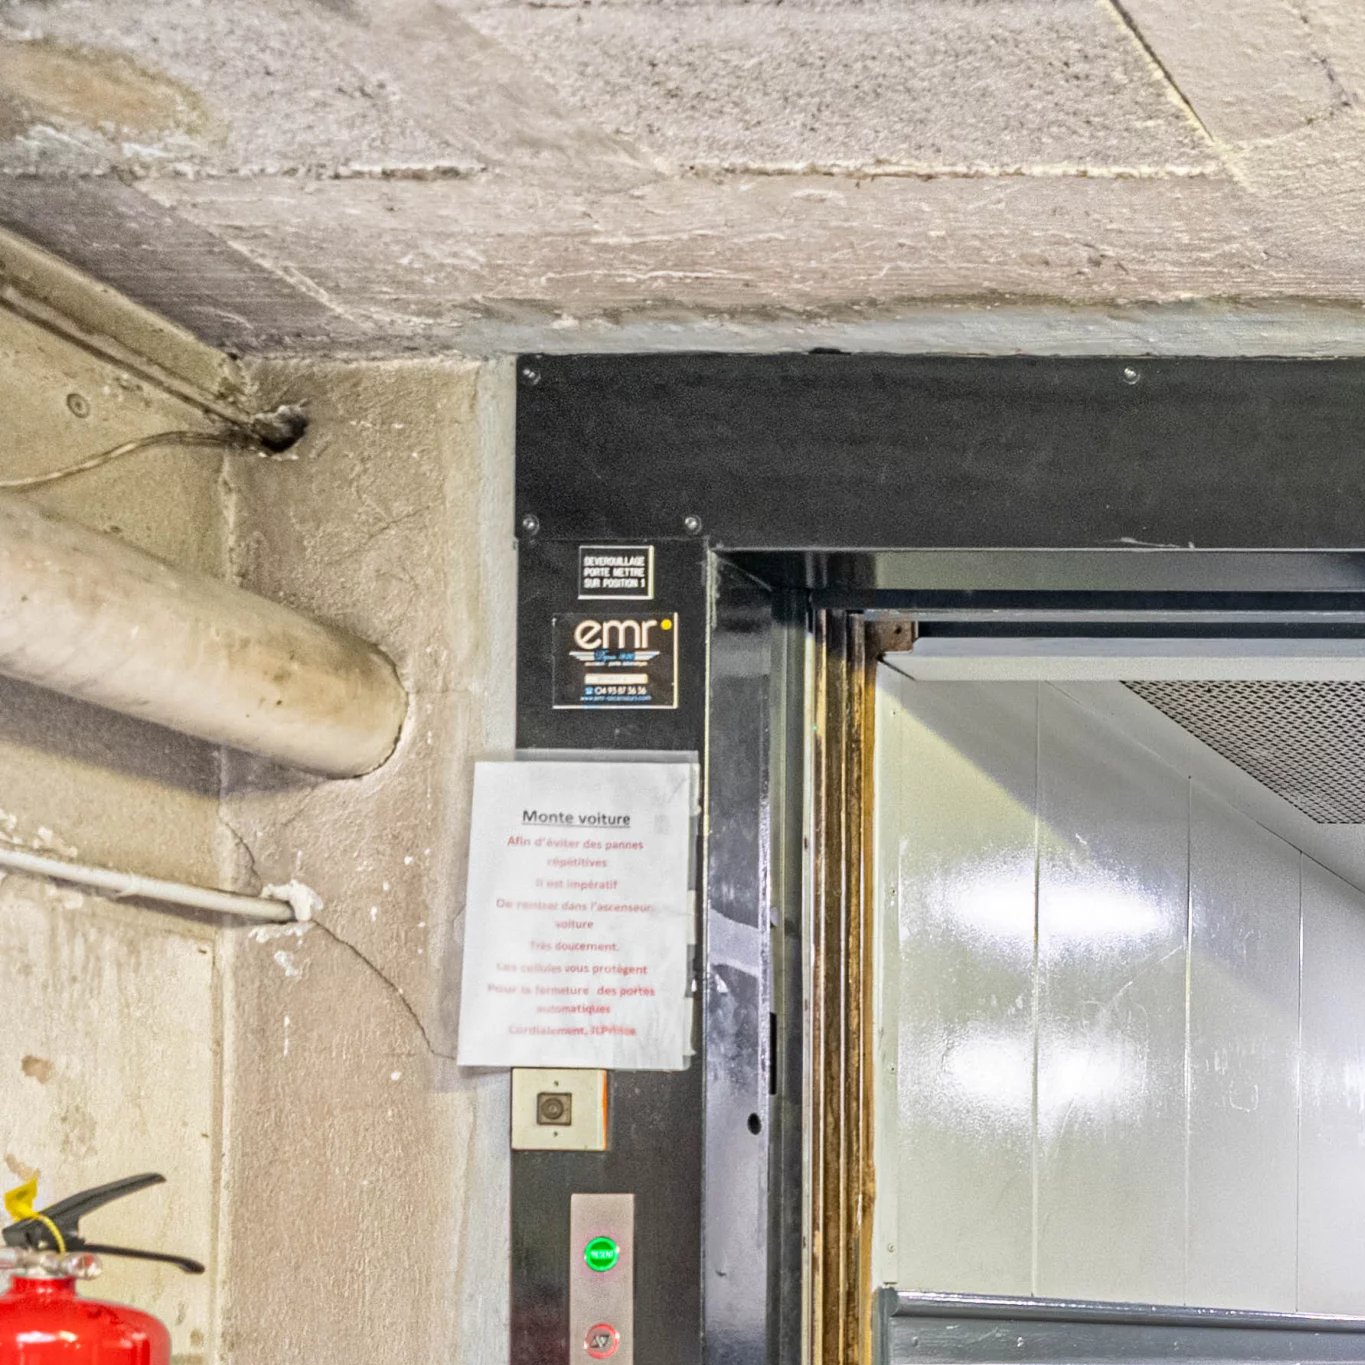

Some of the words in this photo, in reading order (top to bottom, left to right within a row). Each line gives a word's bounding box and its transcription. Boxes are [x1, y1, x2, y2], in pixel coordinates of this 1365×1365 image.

[583, 567, 610, 577] PORTE
[613, 567, 645, 577] METTRE
[583, 578, 600, 588] SUR
[603, 578, 639, 588] POSITION
[641, 578, 646, 588] 1
[574, 619, 658, 650] emr
[522, 809, 574, 824] Monte
[579, 812, 631, 825] voiture
[507, 835, 531, 846] Afin
[583, 839, 602, 849] des
[605, 841, 644, 850] pannes
[562, 901, 587, 911] dans
[555, 919, 594, 929] voiture
[564, 965, 589, 974] vous
[597, 985, 616, 995] des
[620, 987, 656, 997] portes
